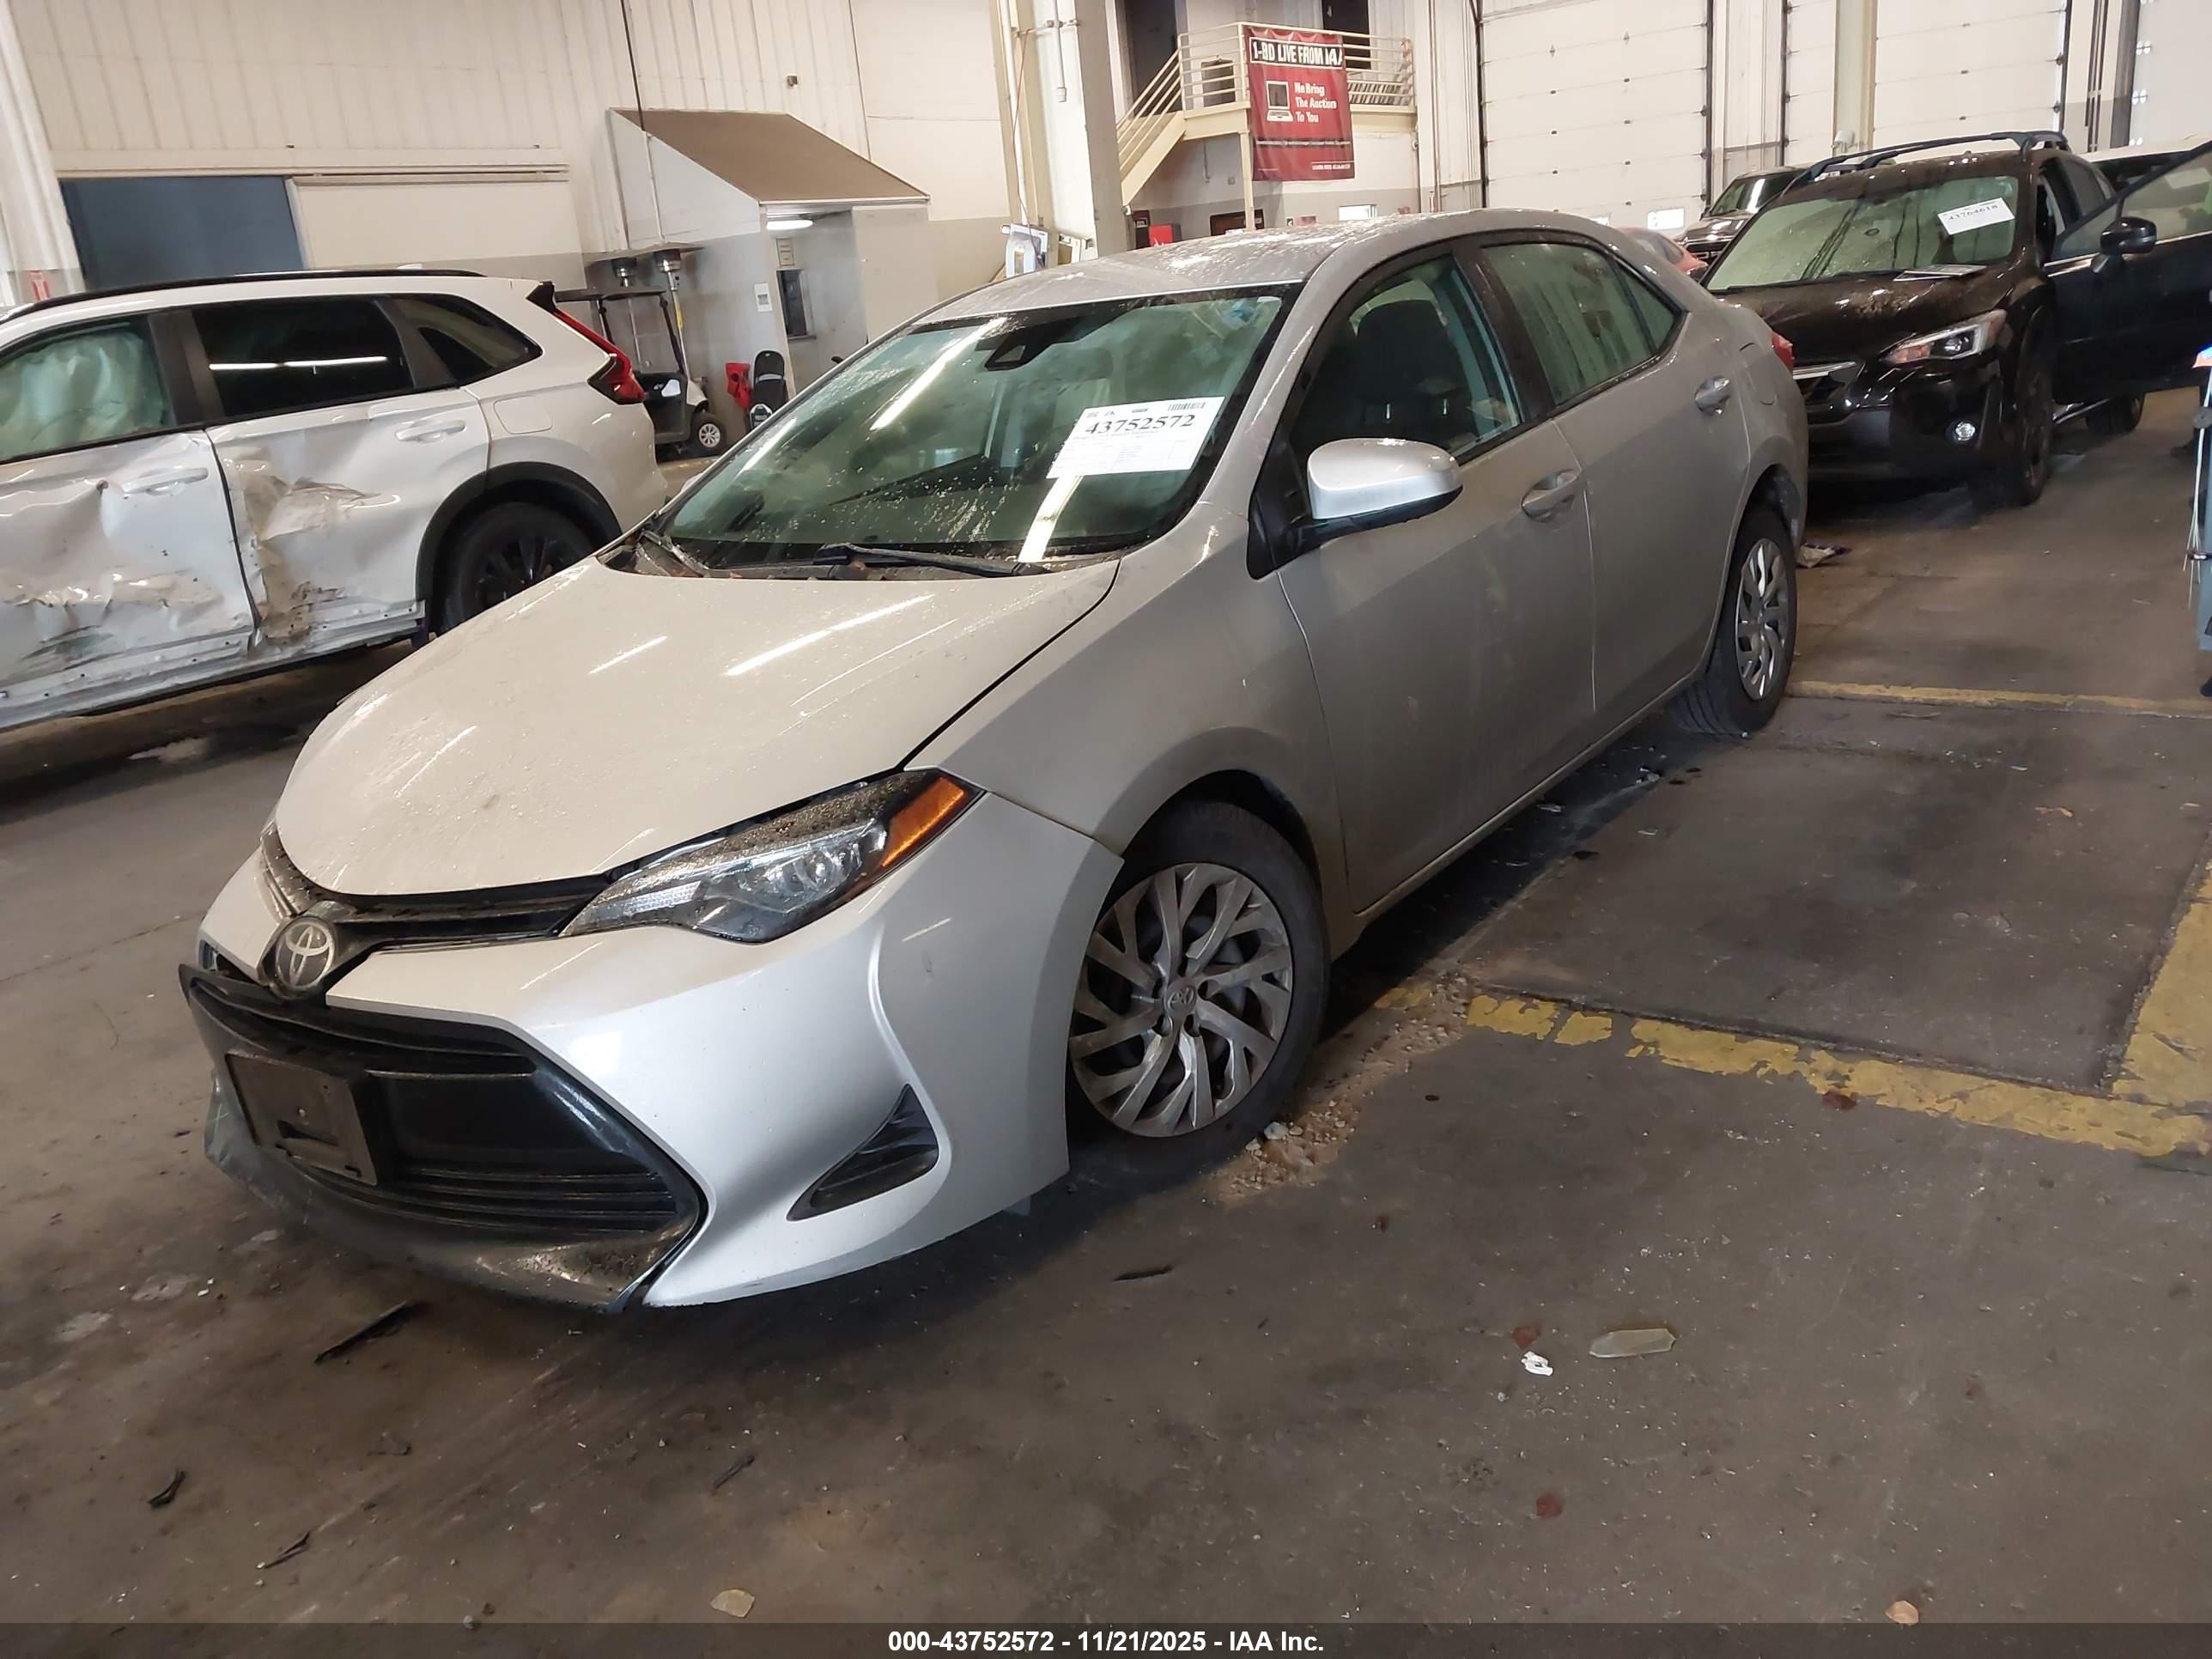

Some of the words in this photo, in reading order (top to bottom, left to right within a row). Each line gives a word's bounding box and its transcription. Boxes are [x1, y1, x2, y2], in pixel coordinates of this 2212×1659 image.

[1278, 44, 1297, 63] LIVE
[1298, 46, 1324, 65] FROM
[1305, 83, 1325, 96] Bring
[1295, 97, 1309, 108] The
[1309, 98, 1337, 109] Auction
[1296, 112, 1304, 122] To
[1305, 112, 1319, 123] You
[1085, 414, 1195, 434] 43752572
